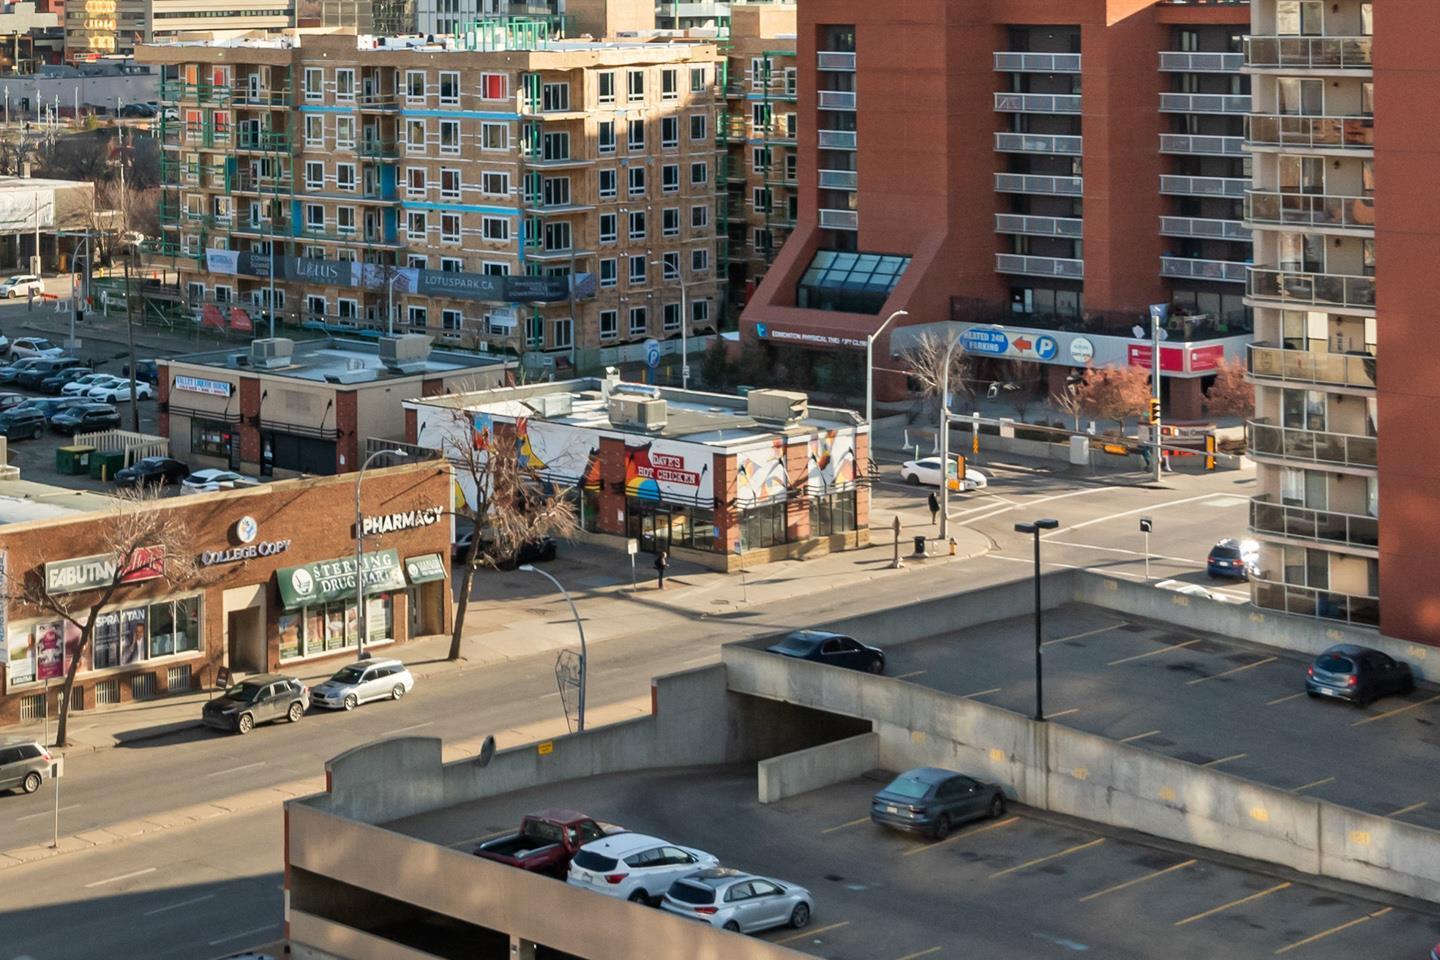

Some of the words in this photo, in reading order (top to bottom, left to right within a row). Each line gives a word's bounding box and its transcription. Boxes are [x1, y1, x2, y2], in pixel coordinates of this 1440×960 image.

[424, 275, 495, 290] LOTUSPARK.CA
[969, 342, 999, 352] PARKING
[1039, 338, 1054, 356] P
[653, 455, 681, 468] DAVE'S
[637, 465, 655, 478] HOT
[656, 469, 696, 484] CHICKEN
[362, 506, 444, 535] PHARMACY
[201, 545, 258, 566] COLLEGE
[258, 539, 292, 556] COPY
[48, 560, 118, 589] FABUTAN
[321, 576, 357, 593] DRUG
[95, 611, 126, 627] SPRAY
[126, 609, 146, 621] TAN
